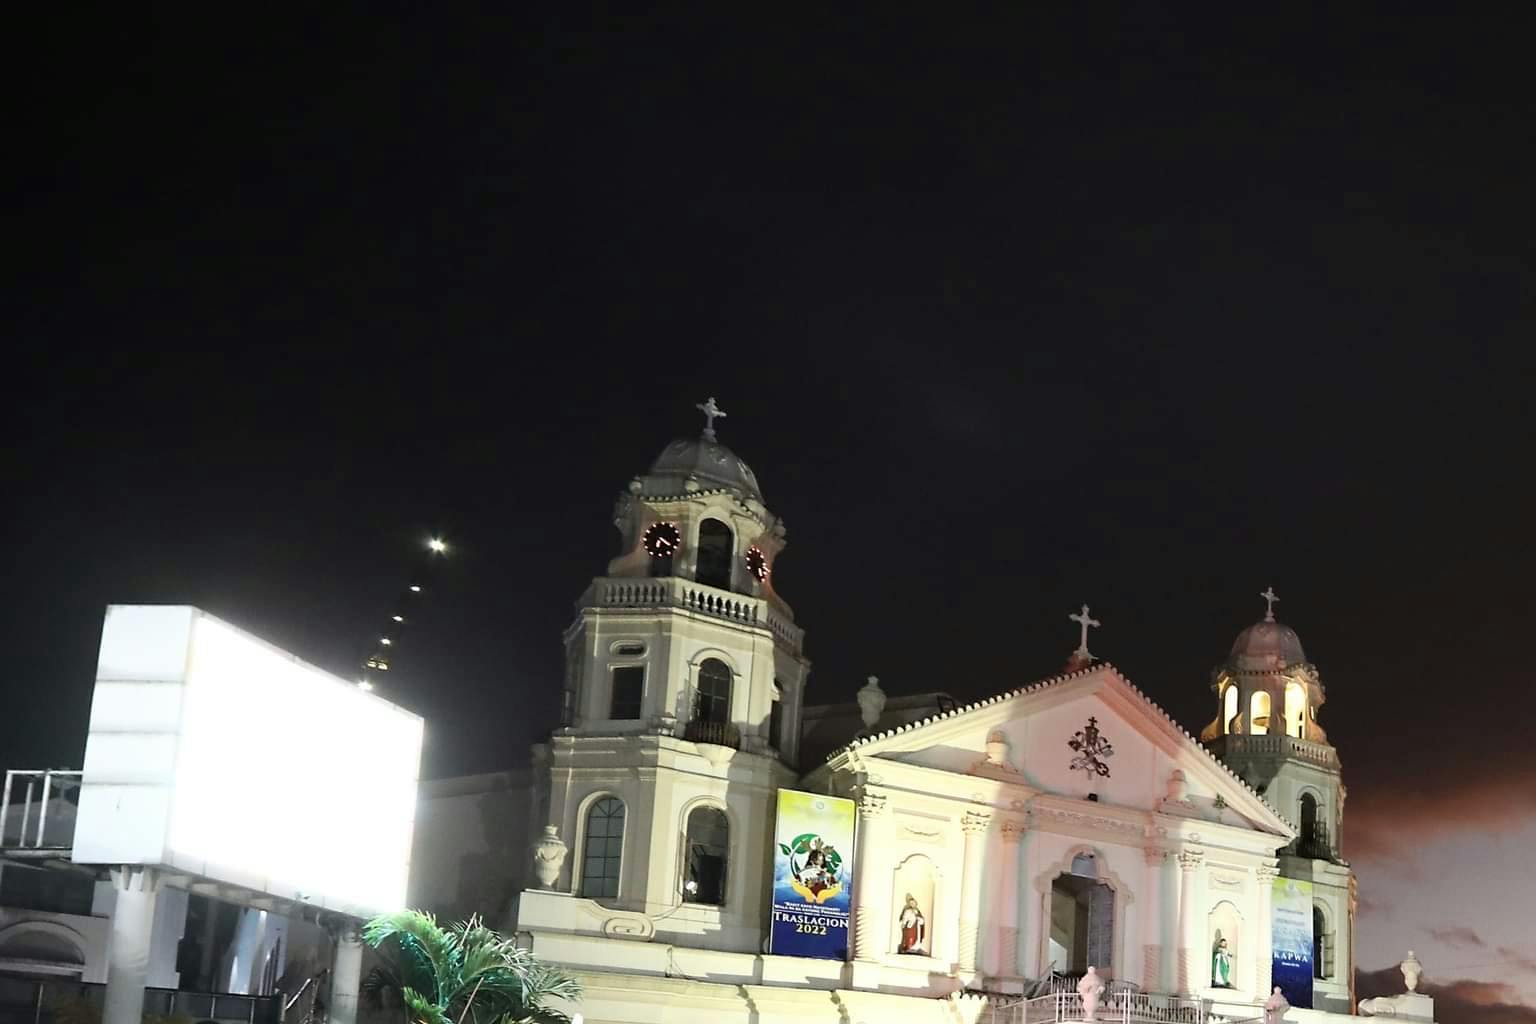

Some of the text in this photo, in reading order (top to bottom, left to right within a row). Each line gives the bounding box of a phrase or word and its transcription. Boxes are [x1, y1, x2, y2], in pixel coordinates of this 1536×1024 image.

[773, 911, 849, 929] TRASLACION
[796, 923, 827, 935] 2022
[1273, 951, 1308, 963] KAPWA
